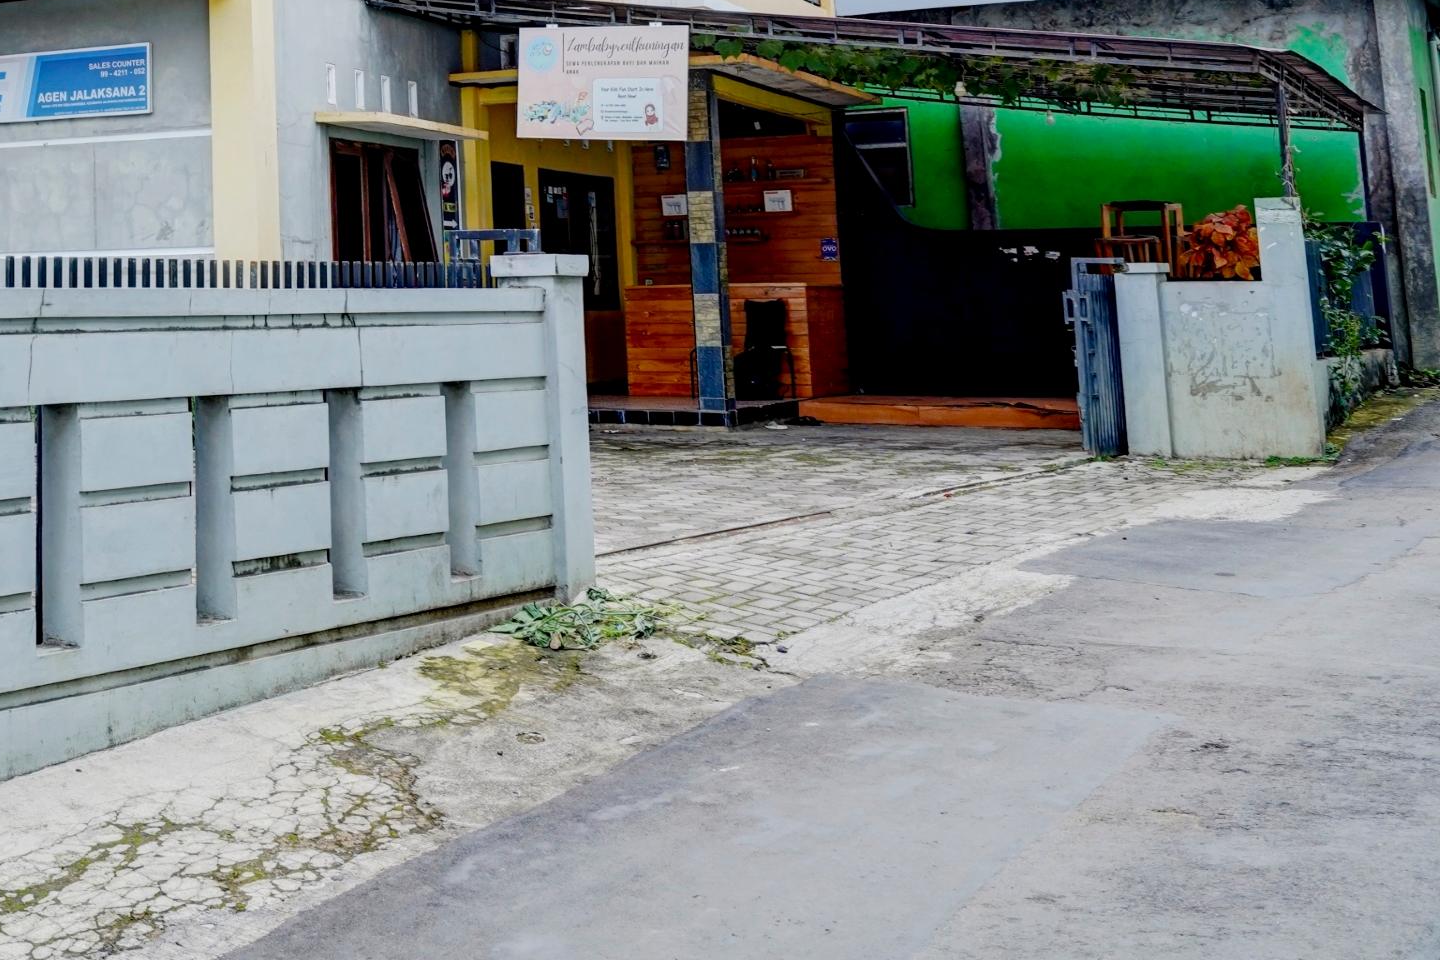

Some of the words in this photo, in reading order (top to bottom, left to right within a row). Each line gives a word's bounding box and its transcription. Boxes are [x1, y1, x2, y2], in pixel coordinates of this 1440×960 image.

[88, 62, 111, 70] SALES
[111, 59, 146, 68] COUNTER
[113, 69, 128, 77] 4211
[37, 91, 67, 104] AGEN
[70, 86, 136, 101] JALAKSANA
[138, 85, 146, 96] 2
